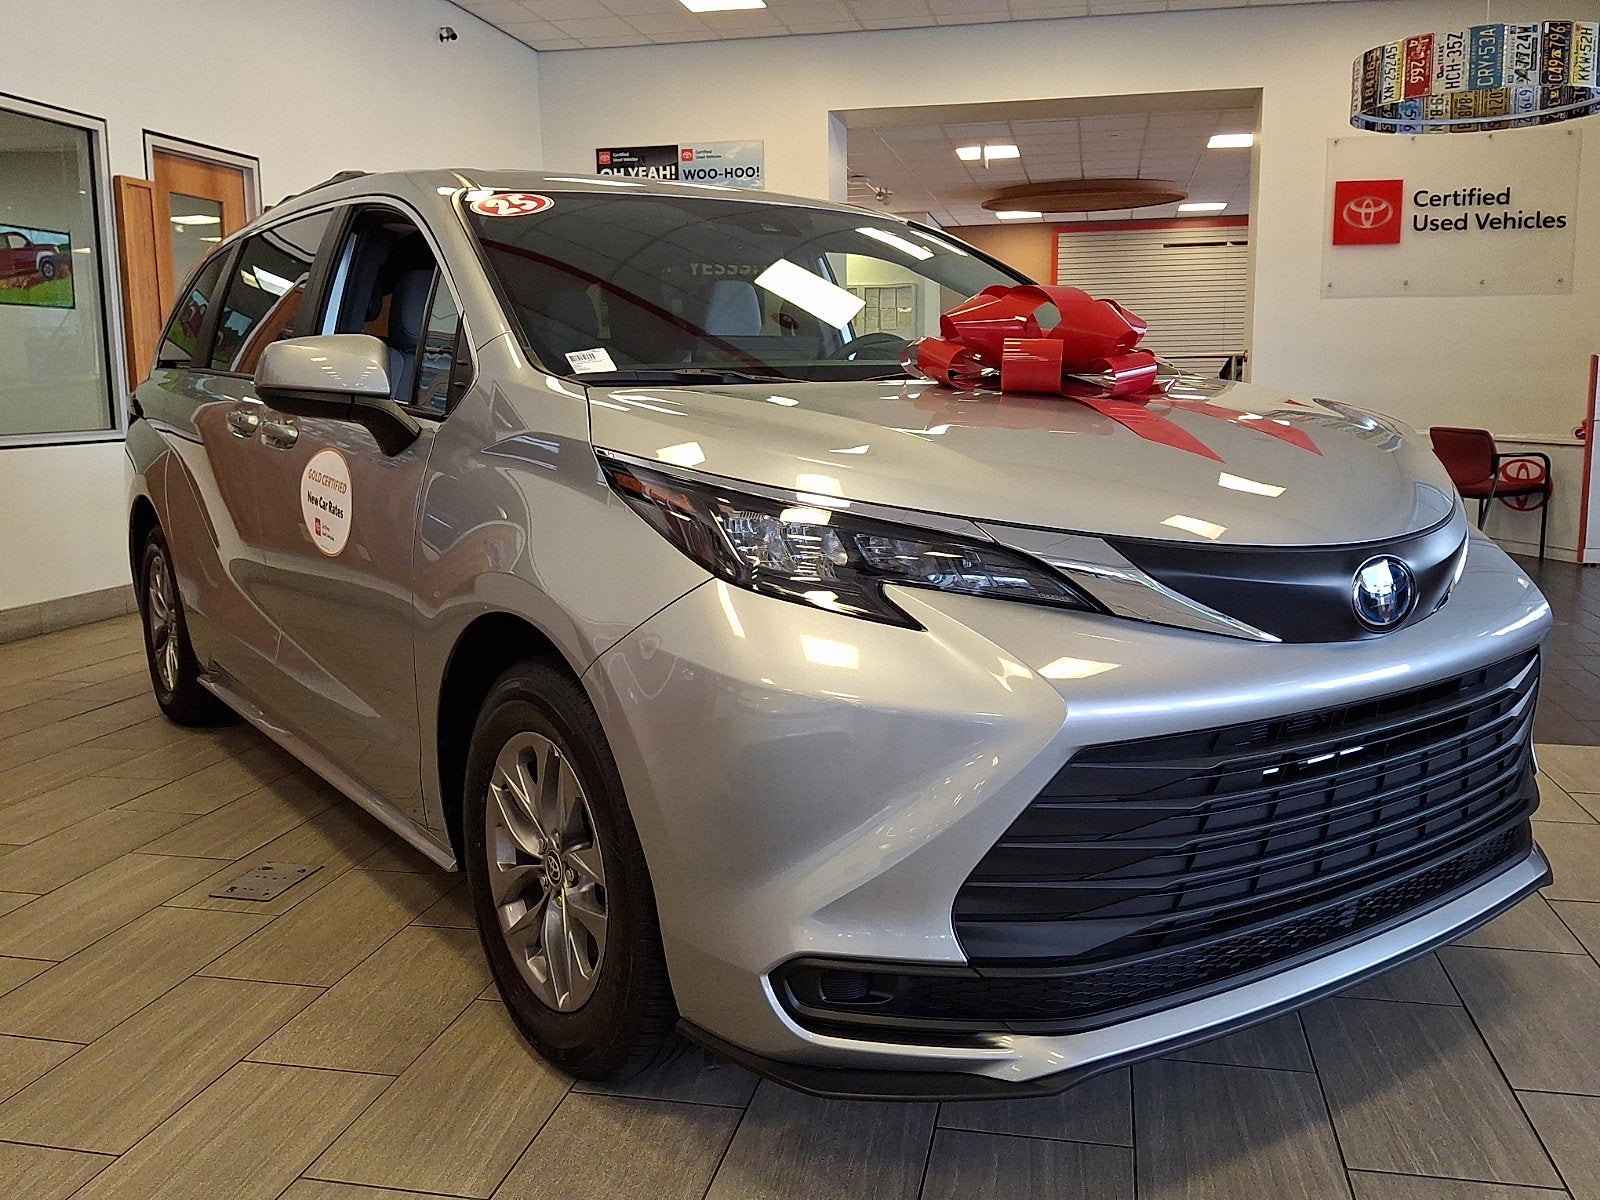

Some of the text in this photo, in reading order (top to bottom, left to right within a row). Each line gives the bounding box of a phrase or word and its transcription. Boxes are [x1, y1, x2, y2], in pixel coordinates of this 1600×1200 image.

[1410, 60, 1425, 84] 266
[628, 166, 676, 180] YEAH!
[683, 166, 760, 180] WOO-HOO!
[485, 194, 538, 215] 25
[1413, 186, 1511, 208] Certified
[1412, 210, 1567, 232] Used Vehicles
[308, 468, 347, 494] GOLD CERTIFIED
[308, 490, 344, 520] New Car Rates
